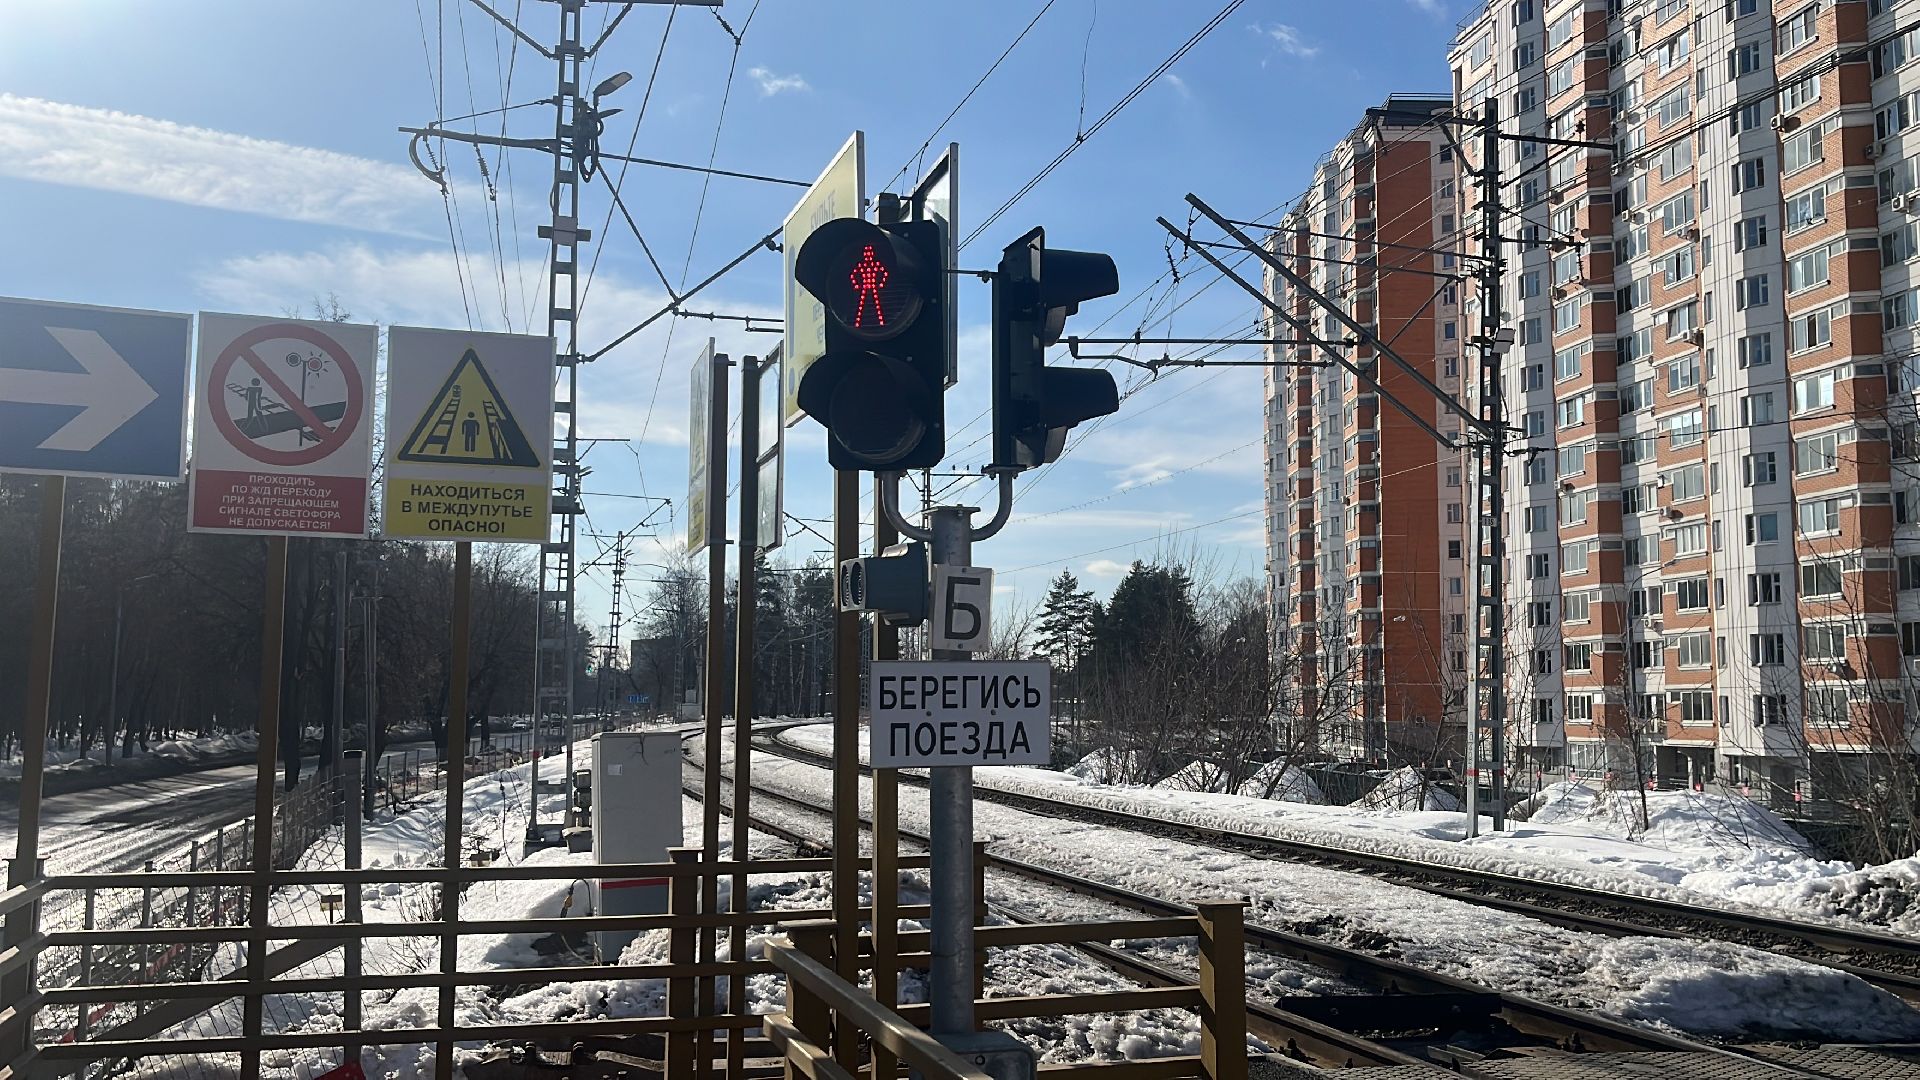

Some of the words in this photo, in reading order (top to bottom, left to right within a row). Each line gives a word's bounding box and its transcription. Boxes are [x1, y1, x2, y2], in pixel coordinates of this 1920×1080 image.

[249, 474, 315, 487] ПРОХОДИТЬ
[231, 485, 248, 494] ПО
[251, 486, 271, 496] Ж/Д
[273, 487, 332, 498] ПЕРЕХОДУ
[410, 483, 525, 501] НАХОДИТЬСЯ
[222, 495, 245, 505] ПРИ
[247, 496, 339, 509] ЗАПРЕЩАЮЩЕМ
[218, 506, 271, 517] СИГНАЛЕ
[273, 508, 341, 519] СВЕТОФОРА
[401, 501, 412, 513] В
[418, 502, 533, 518] МЕЖДУПУТЬЕ
[229, 517, 244, 527] НЕ
[246, 518, 331, 530] ДОПУСКАЕТСЯ!
[428, 519, 505, 533] ОПАСНО!
[944, 576, 982, 640] Б
[879, 675, 1041, 710] БЕРЕГИСЬ
[890, 720, 1031, 760] ПОЕЗДА
